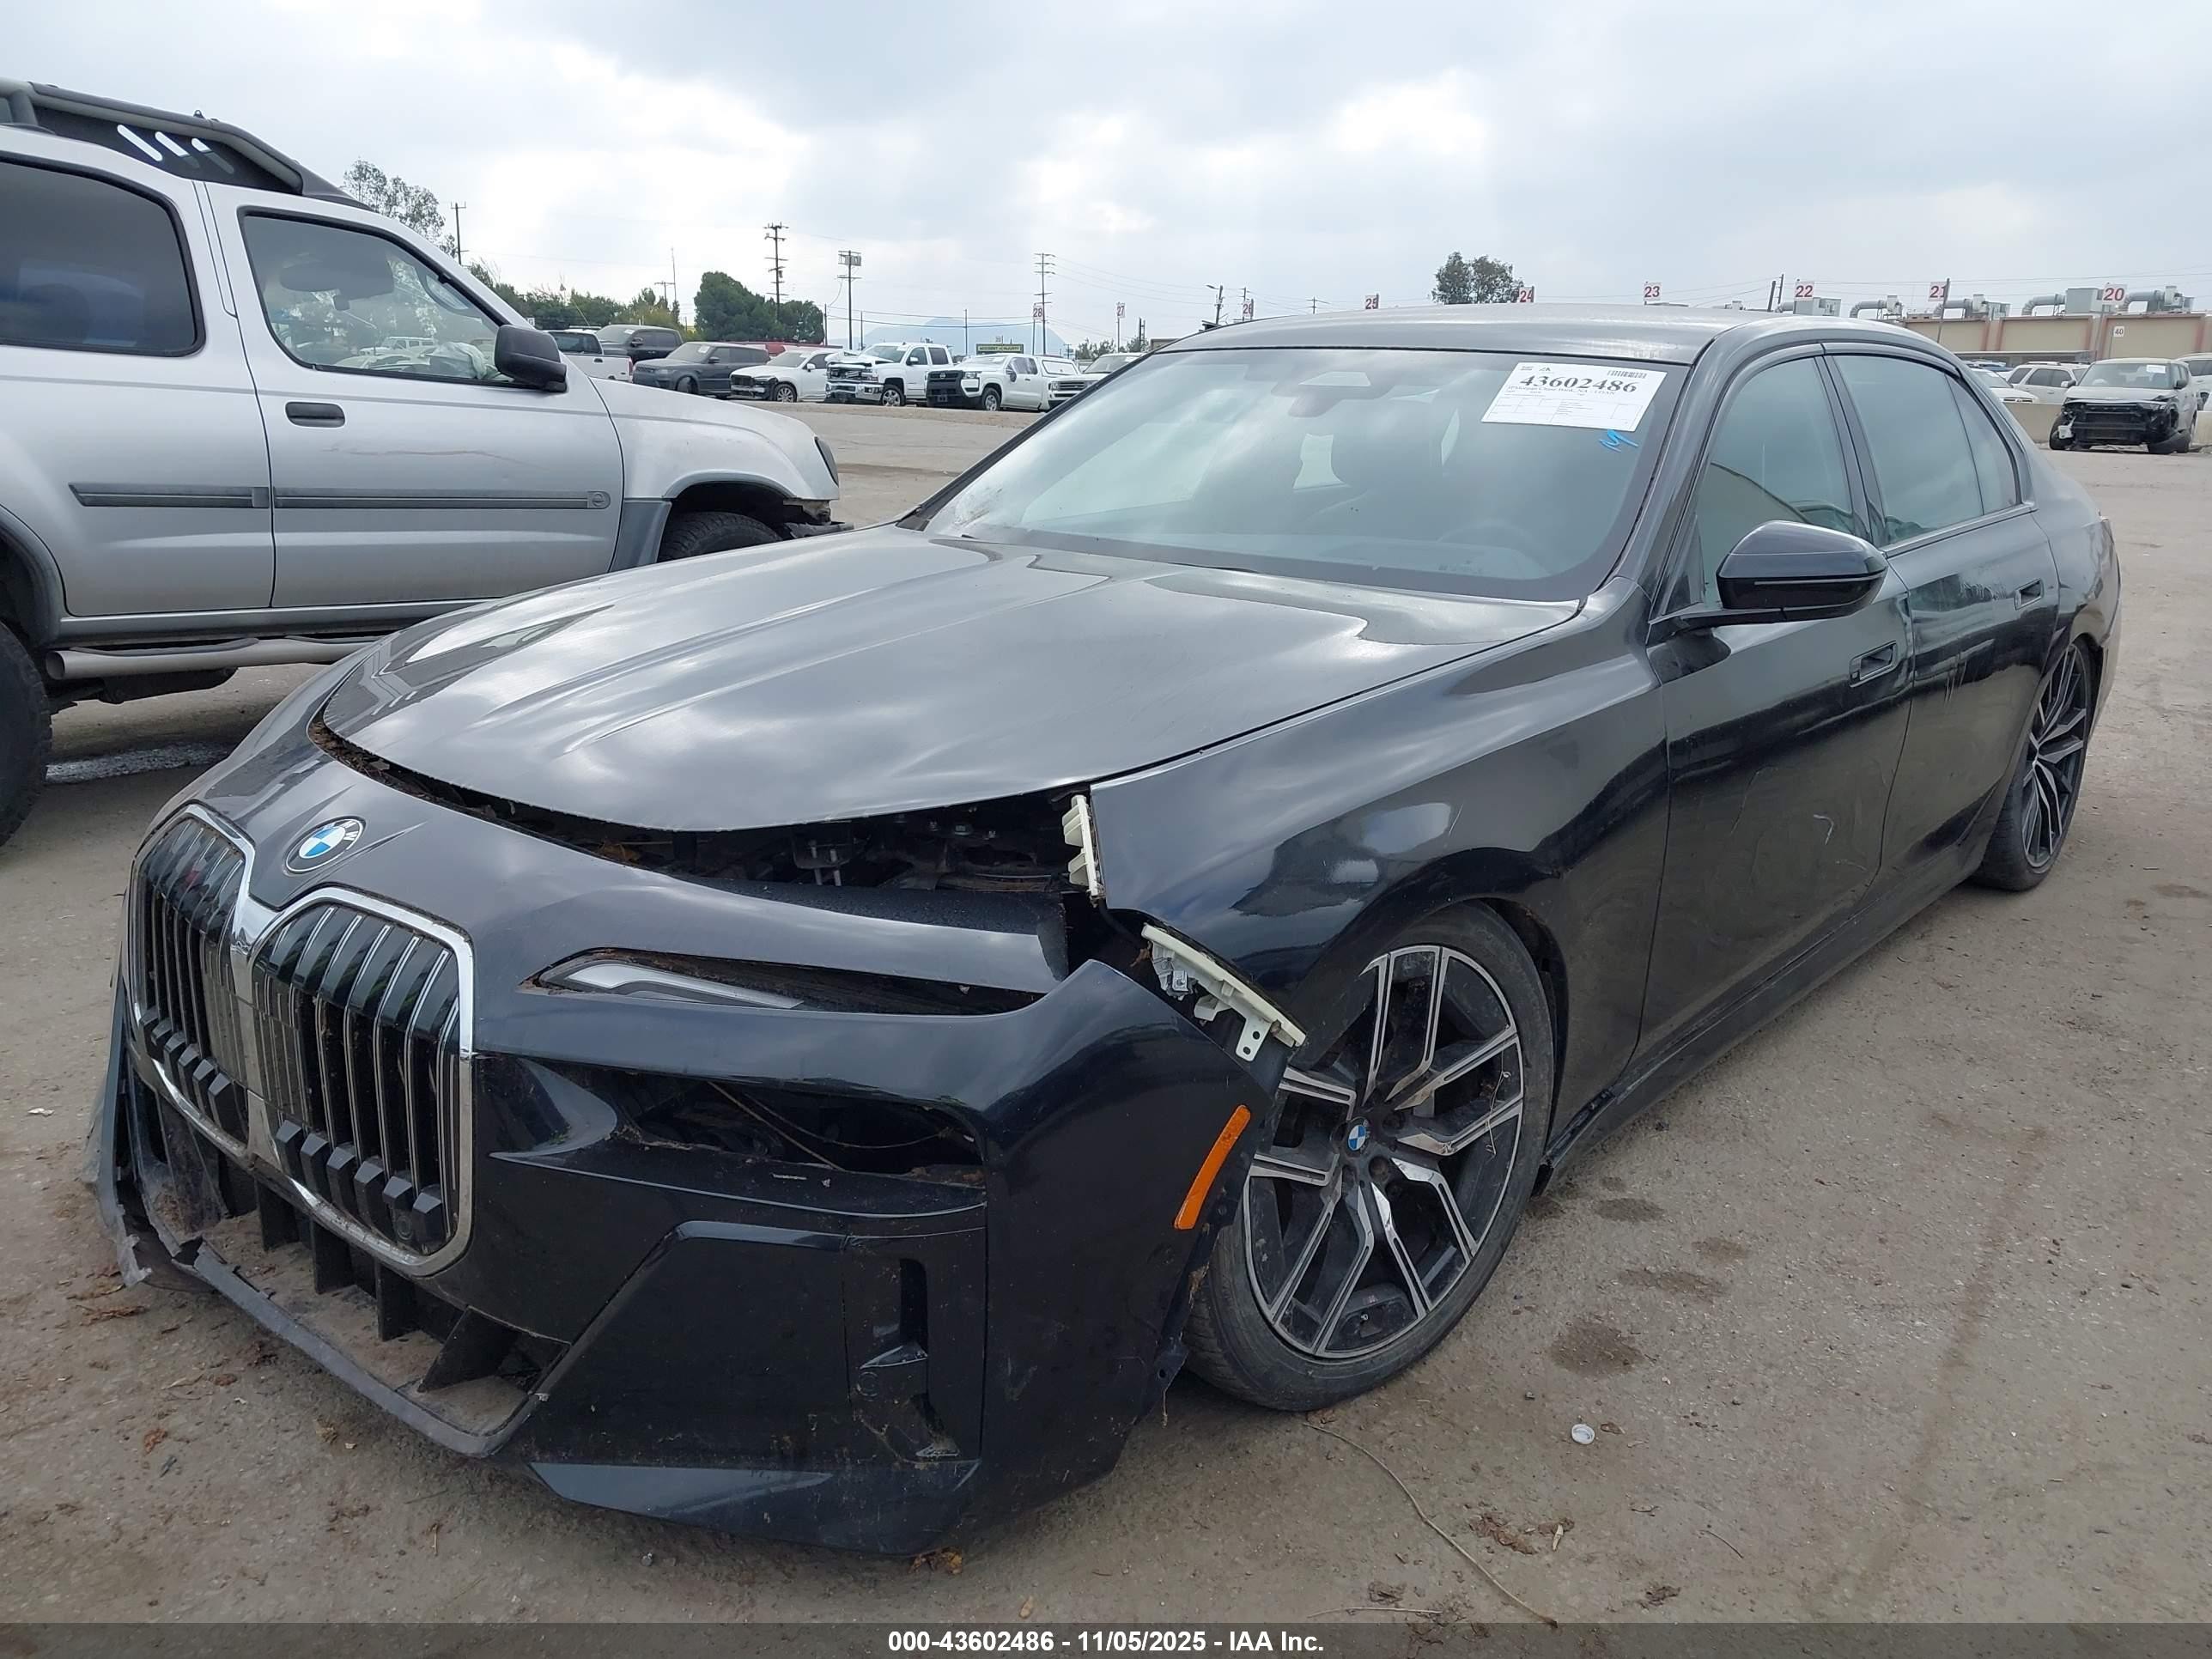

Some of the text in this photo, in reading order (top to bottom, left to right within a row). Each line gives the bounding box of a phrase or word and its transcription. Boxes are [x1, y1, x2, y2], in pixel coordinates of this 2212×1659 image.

[1644, 285, 1660, 298] 23
[1795, 285, 1814, 298] 22
[2103, 288, 2125, 301] 20
[1365, 298, 1377, 310] 25
[1033, 307, 1043, 318] 28
[1116, 306, 1125, 317] 27
[1519, 374, 1641, 393] 43602486
